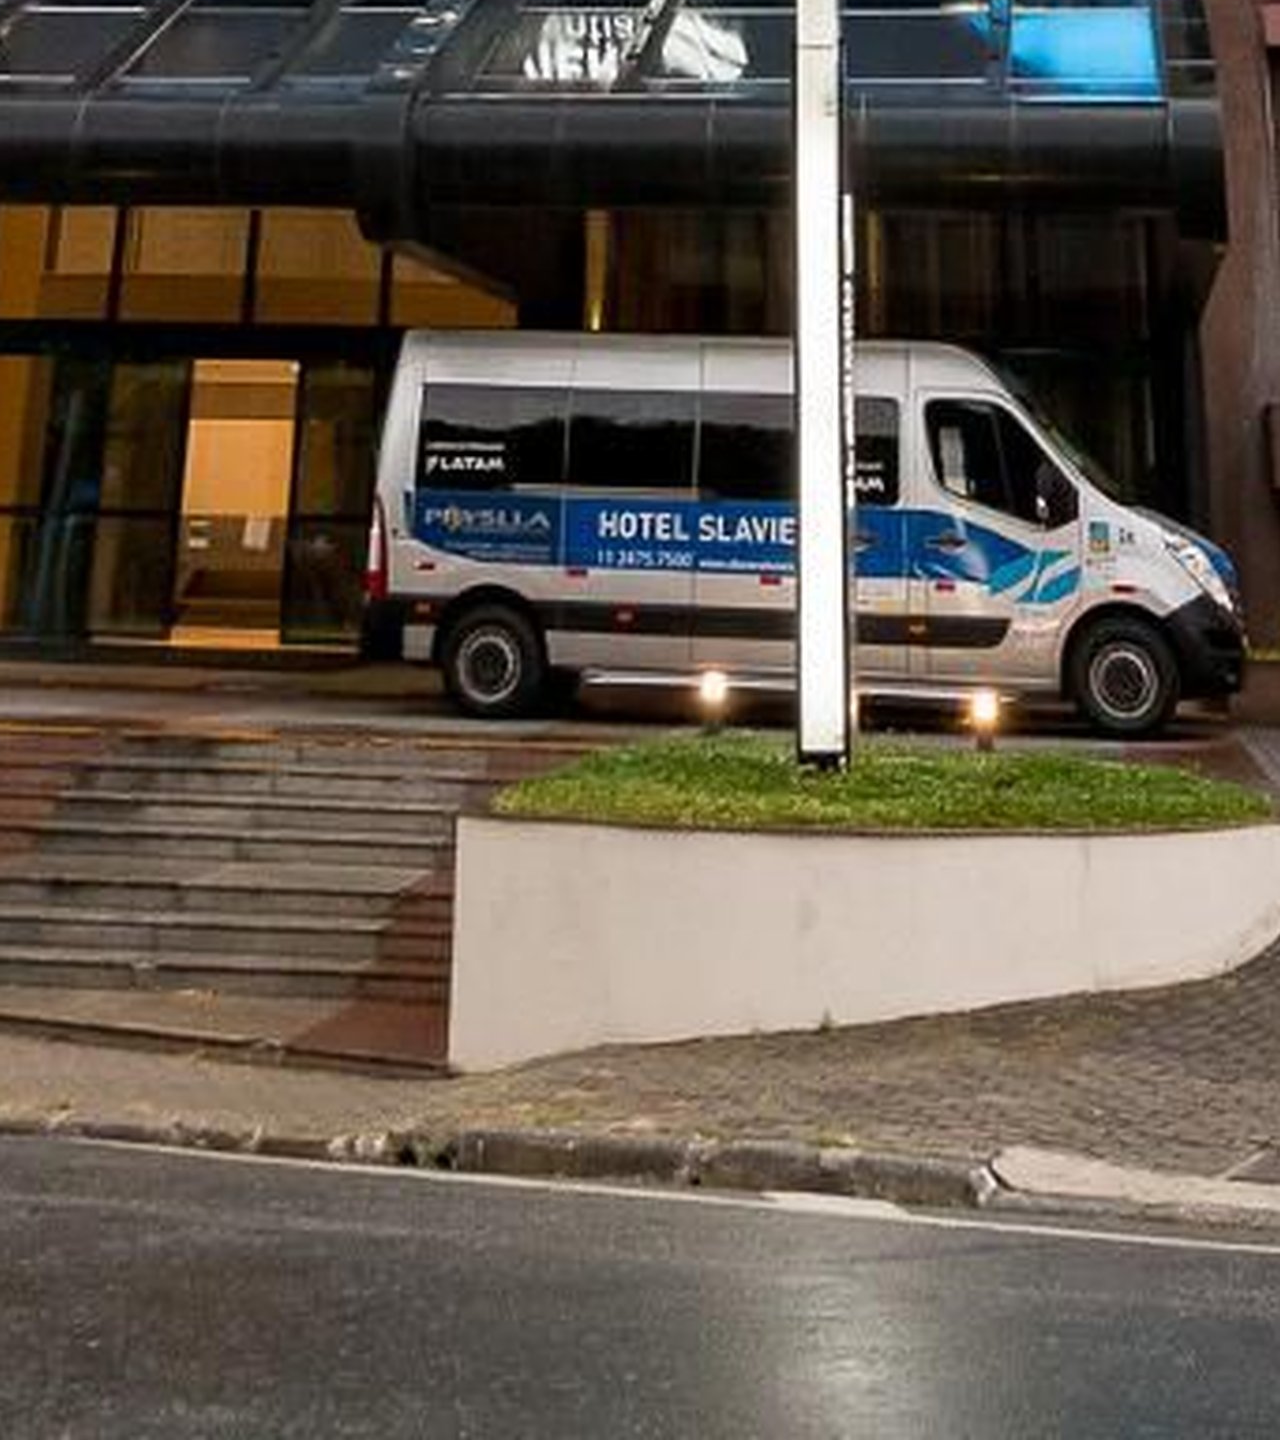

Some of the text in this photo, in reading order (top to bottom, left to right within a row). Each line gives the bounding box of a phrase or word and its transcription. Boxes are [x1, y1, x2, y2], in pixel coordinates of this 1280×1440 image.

[439, 455, 506, 472] LATAM
[598, 509, 797, 546] HOTEL SLAVIE
